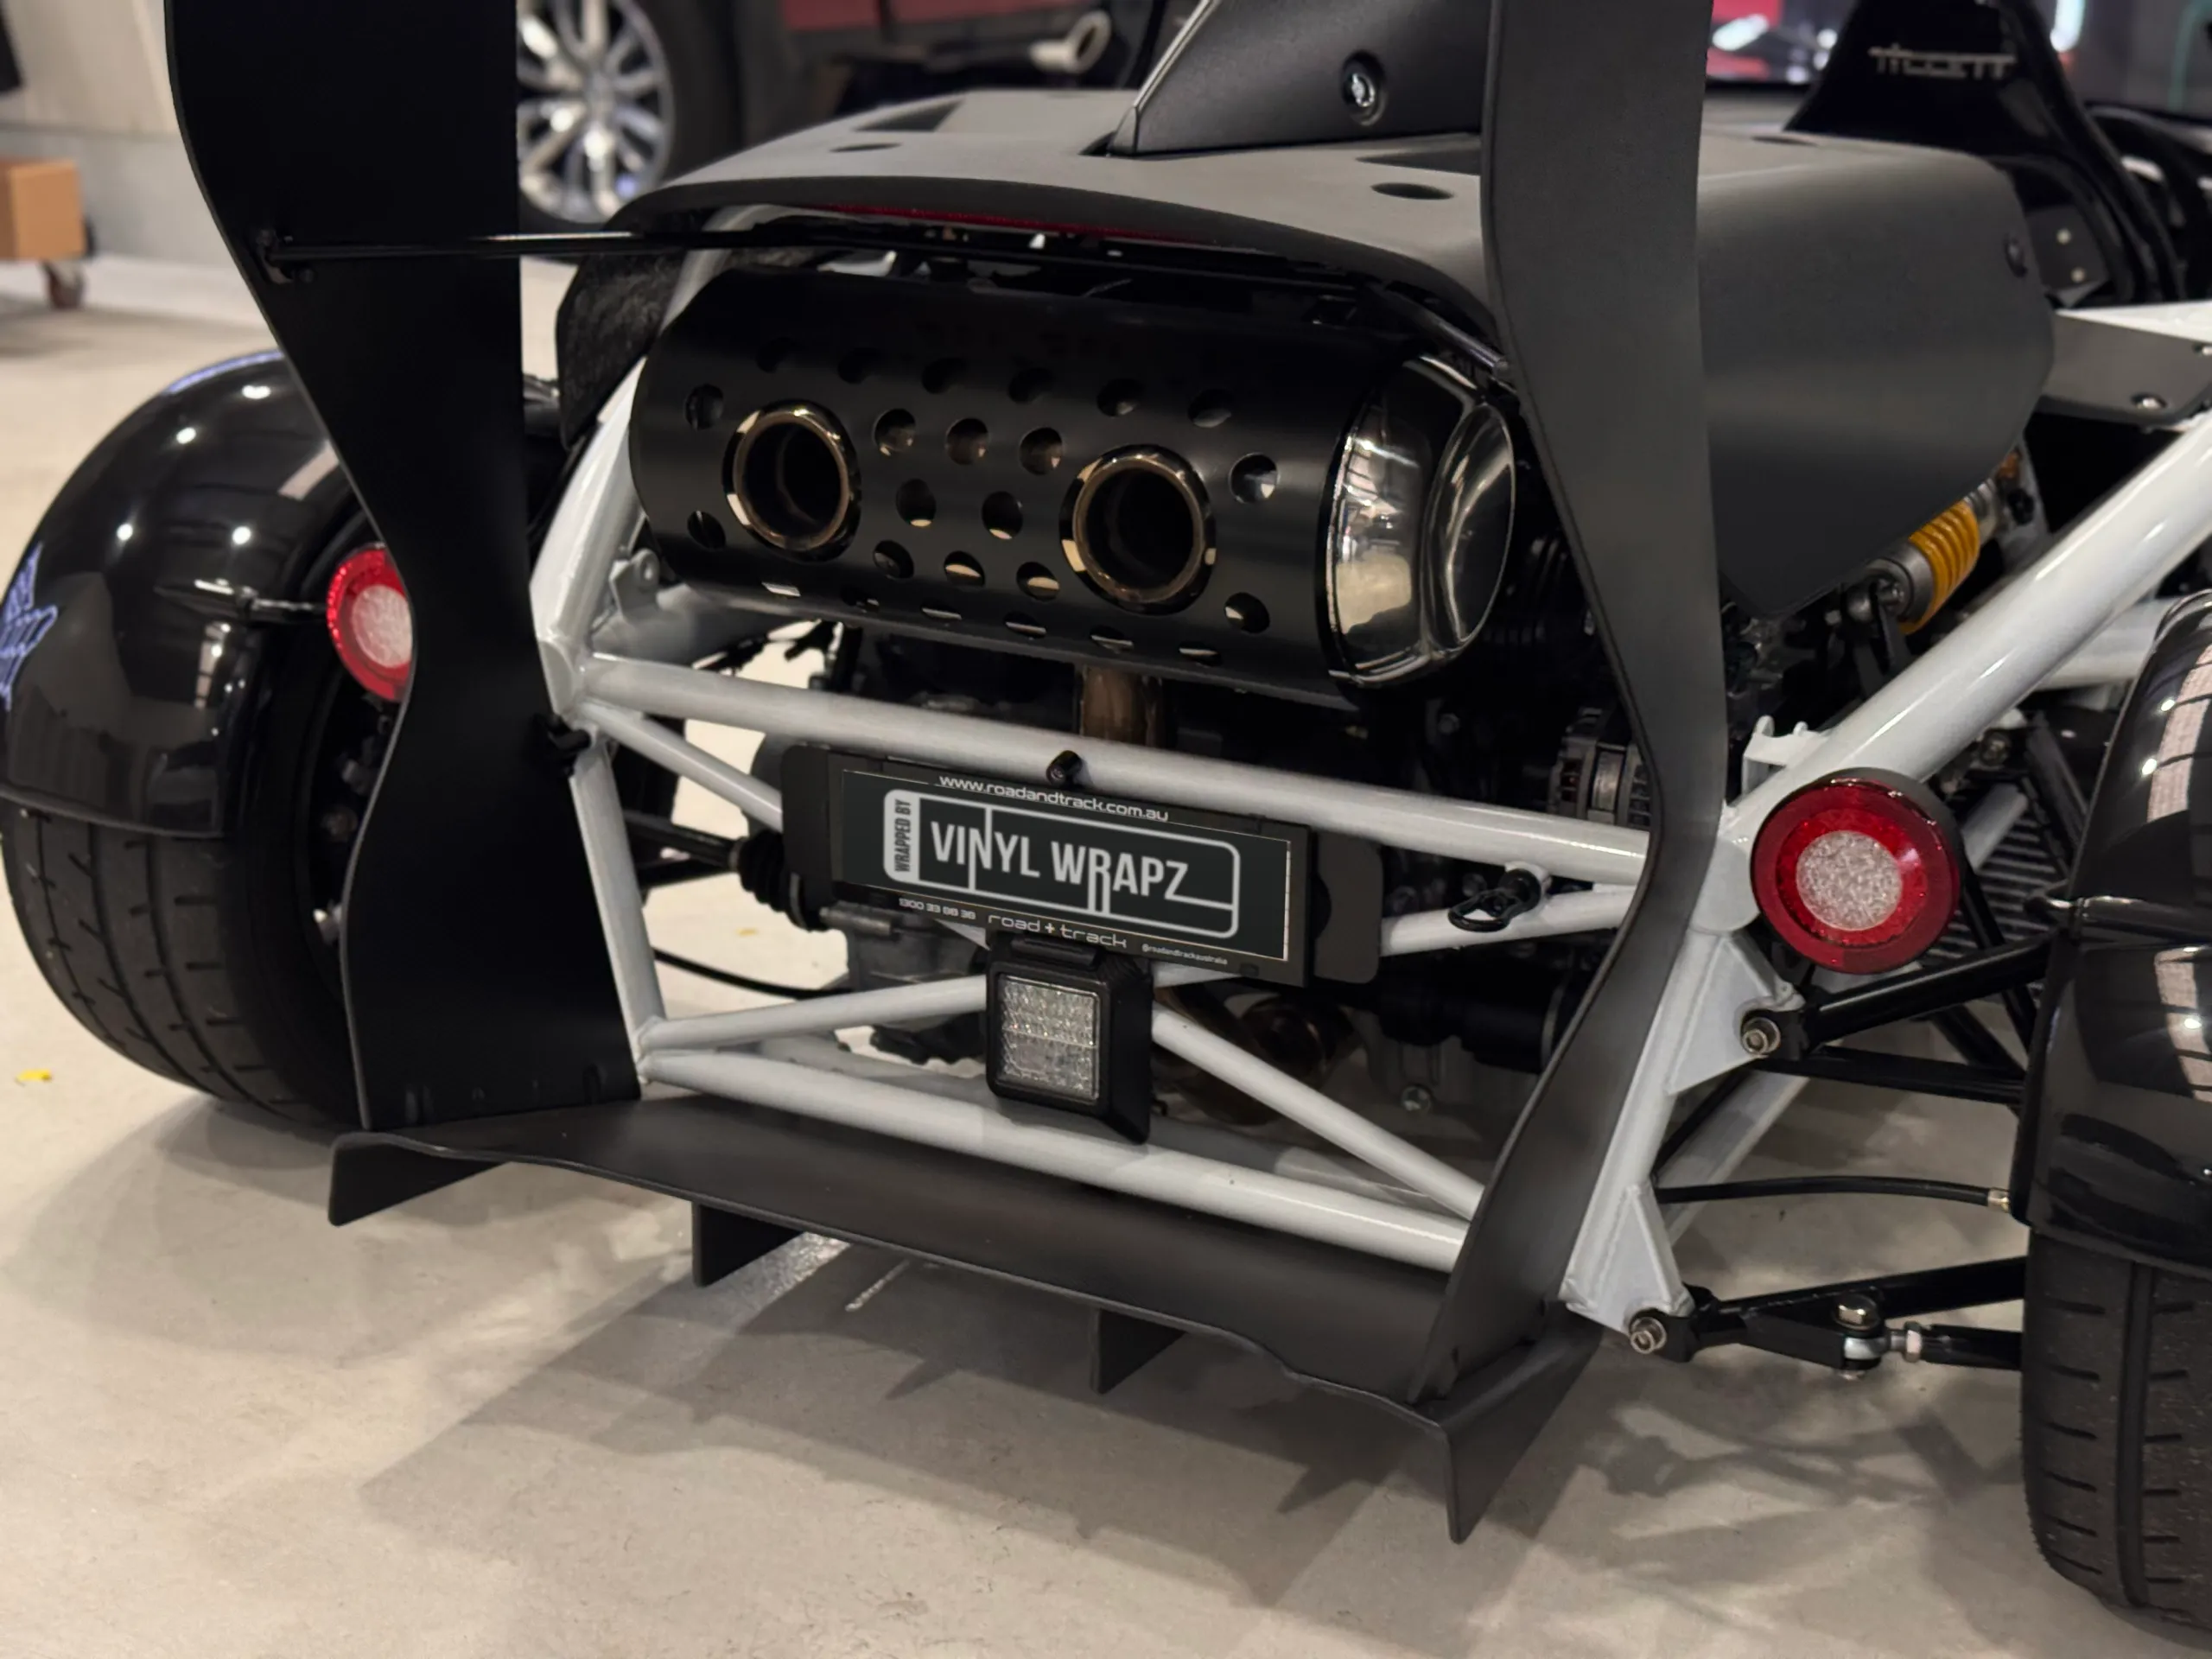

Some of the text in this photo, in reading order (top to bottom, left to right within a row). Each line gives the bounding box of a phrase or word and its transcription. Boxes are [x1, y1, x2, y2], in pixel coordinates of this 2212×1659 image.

[939, 776, 1169, 822] www.roadandtrack.com.au
[894, 798, 912, 873] WRAPPED BY
[931, 815, 1191, 913] VINYL WRAPZ
[988, 913, 1127, 948] road + track
